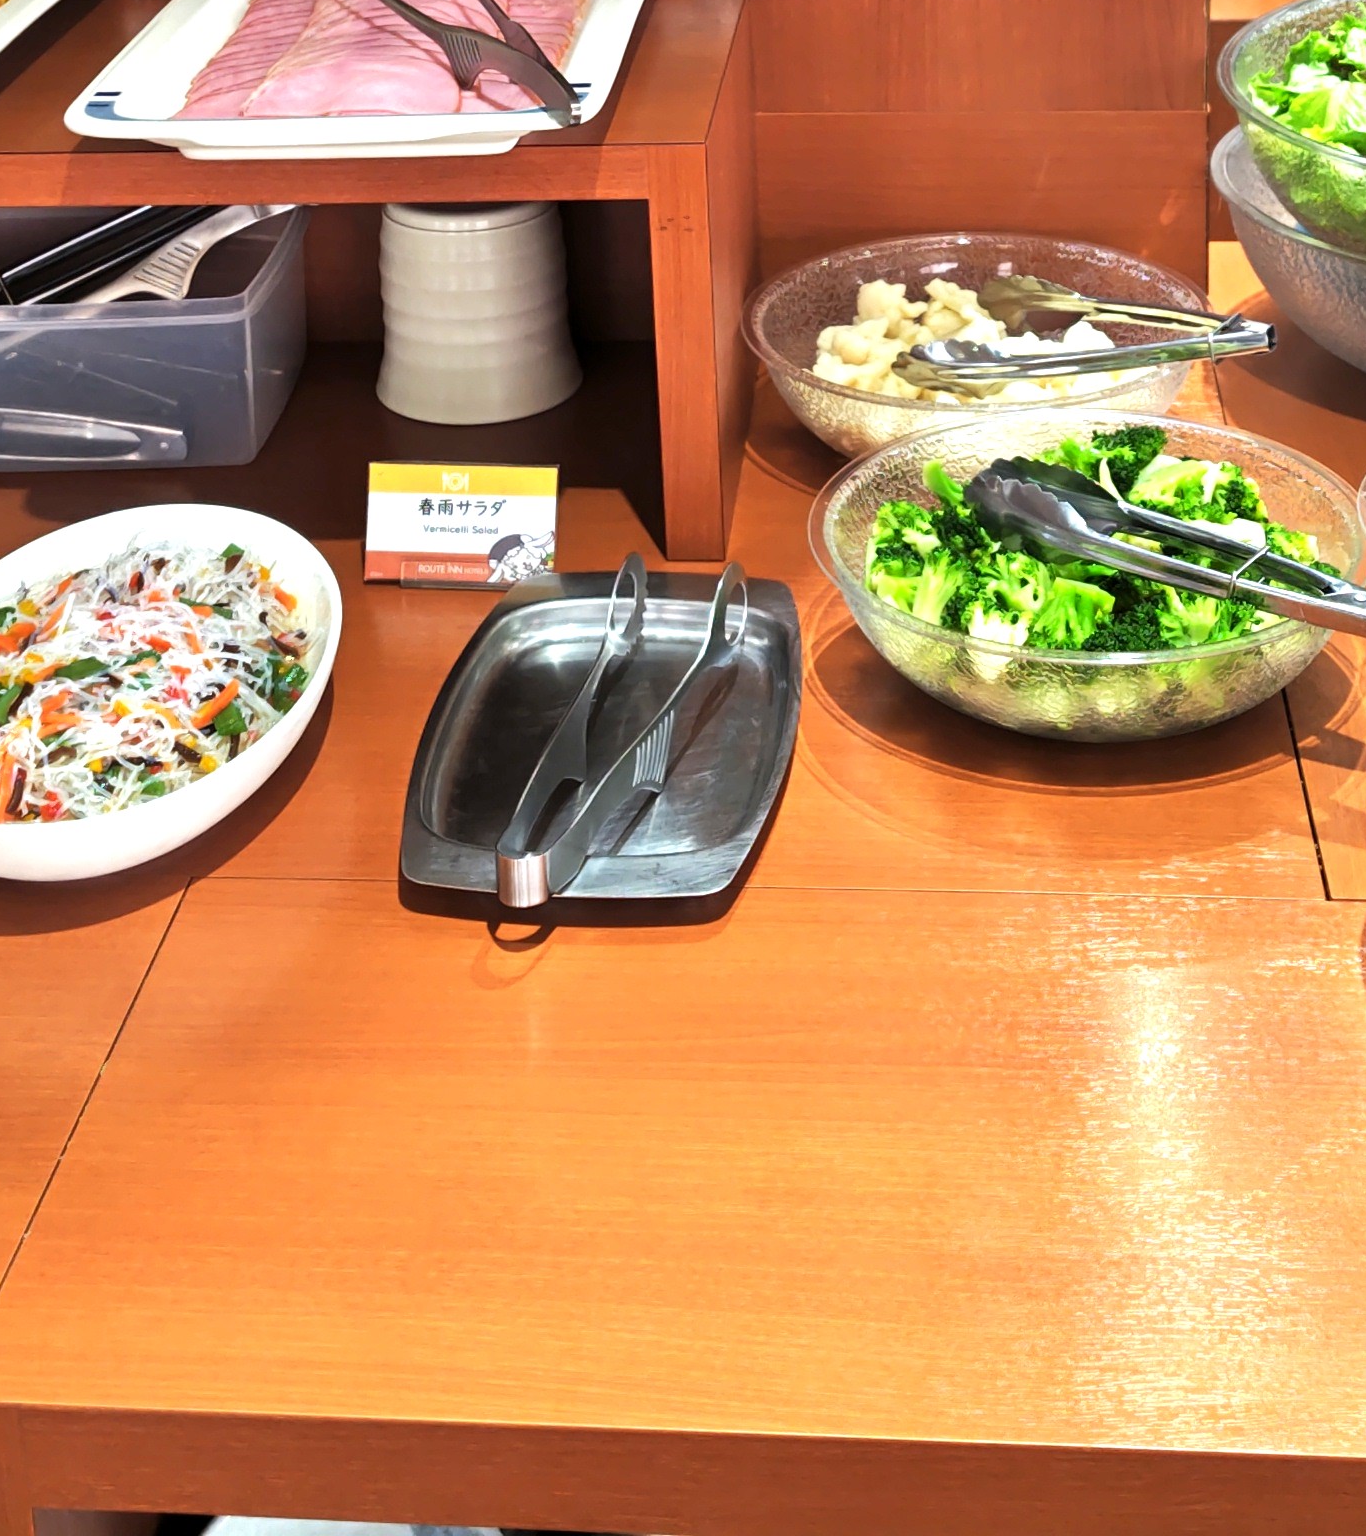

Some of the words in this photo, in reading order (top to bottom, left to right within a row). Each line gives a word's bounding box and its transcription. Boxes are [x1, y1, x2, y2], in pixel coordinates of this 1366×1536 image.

[418, 498, 507, 516] 春雨サラダ
[423, 525, 469, 534] Vermicelli
[472, 526, 499, 535] Salad
